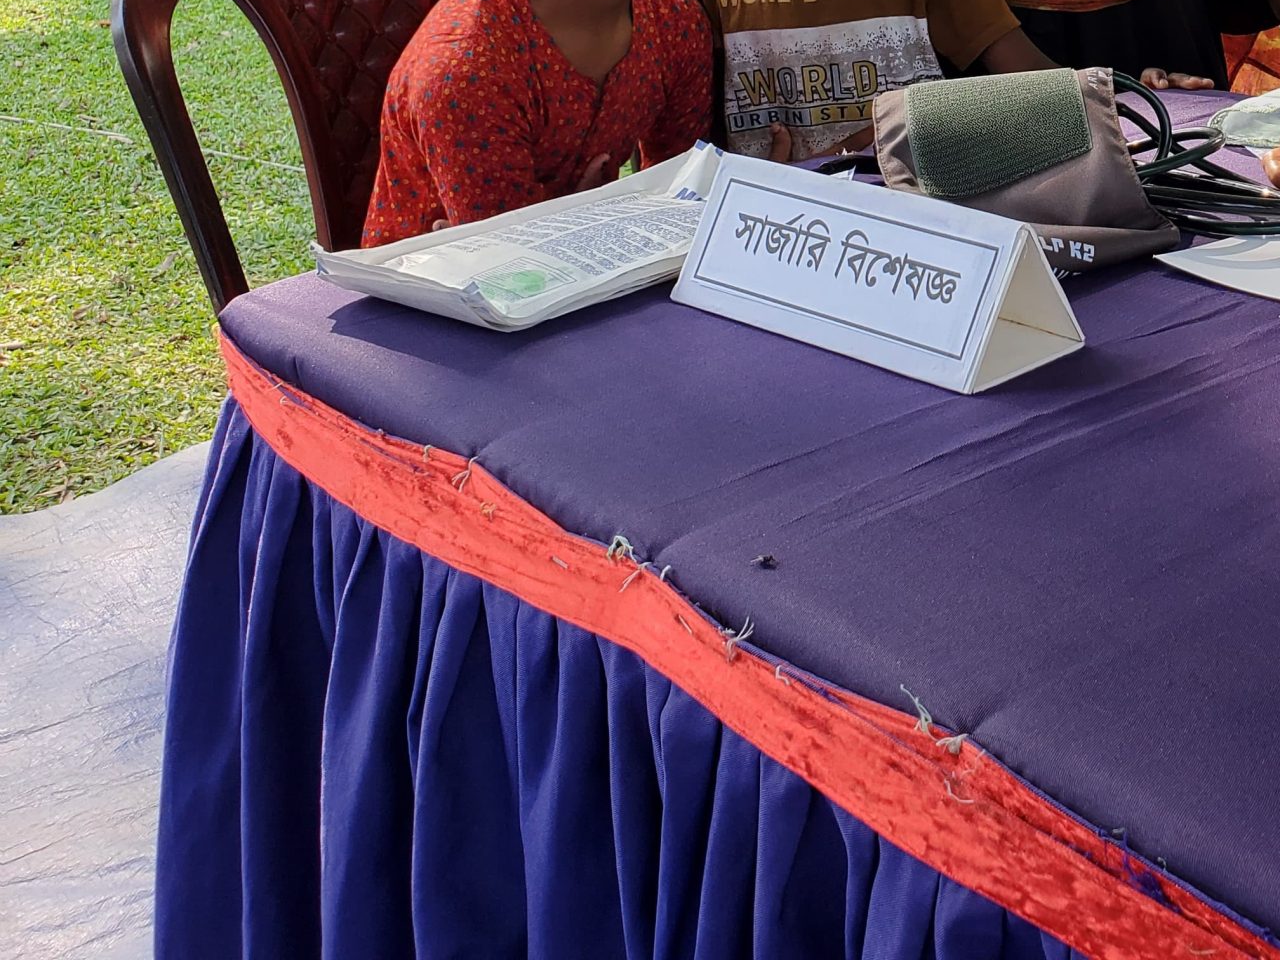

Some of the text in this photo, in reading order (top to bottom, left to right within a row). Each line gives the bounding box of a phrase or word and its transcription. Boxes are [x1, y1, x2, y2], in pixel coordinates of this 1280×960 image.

[738, 60, 878, 106] WORLD
[820, 104, 867, 121] STY
[735, 212, 832, 273] সার্জারি
[834, 228, 962, 305] বিশেষজ্ঞ
[1038, 235, 1095, 263] LP K2
